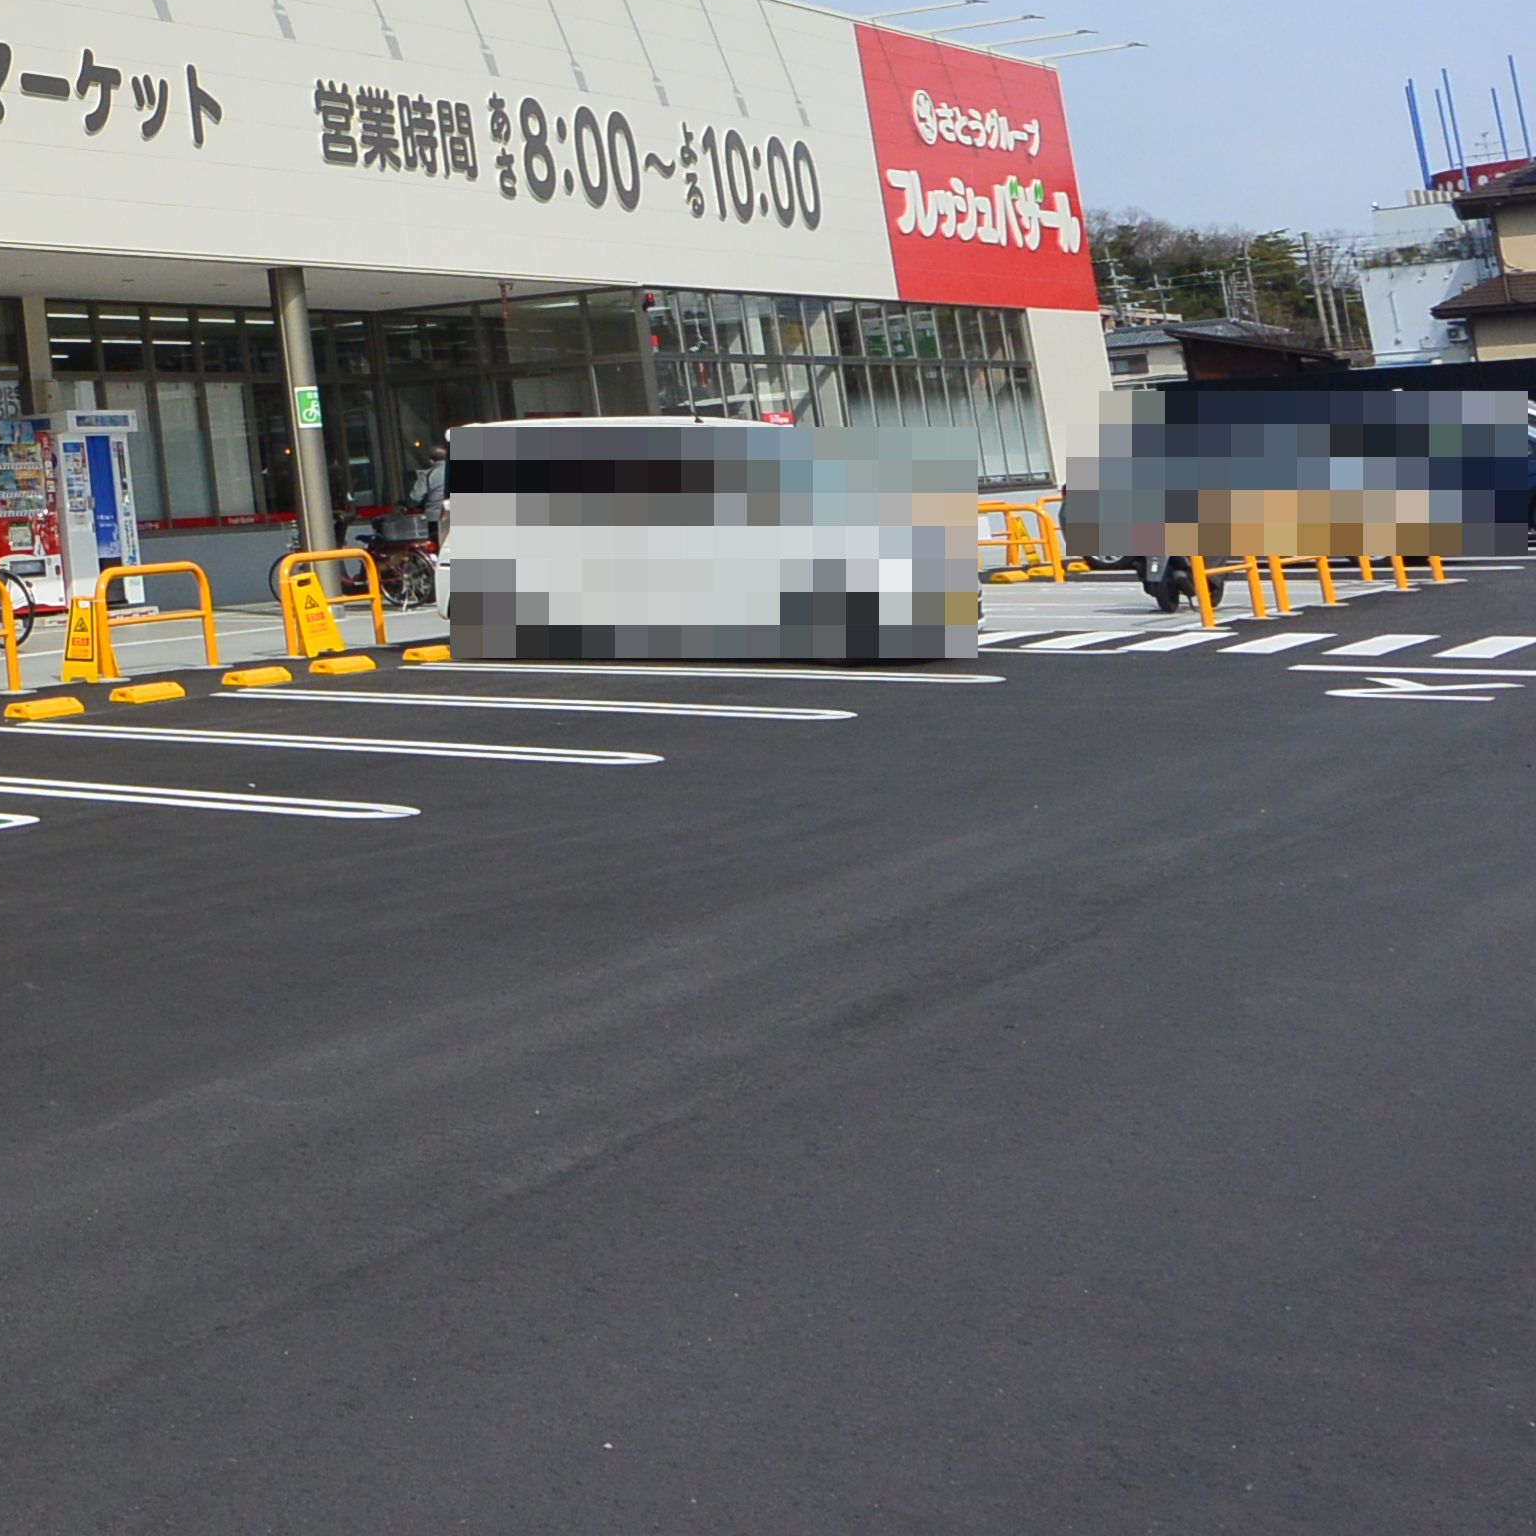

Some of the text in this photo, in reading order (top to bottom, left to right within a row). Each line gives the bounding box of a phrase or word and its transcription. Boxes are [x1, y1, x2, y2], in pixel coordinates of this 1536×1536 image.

[311, 78, 480, 182] 営業時間
[886, 168, 1082, 254] フレッシュバザール
